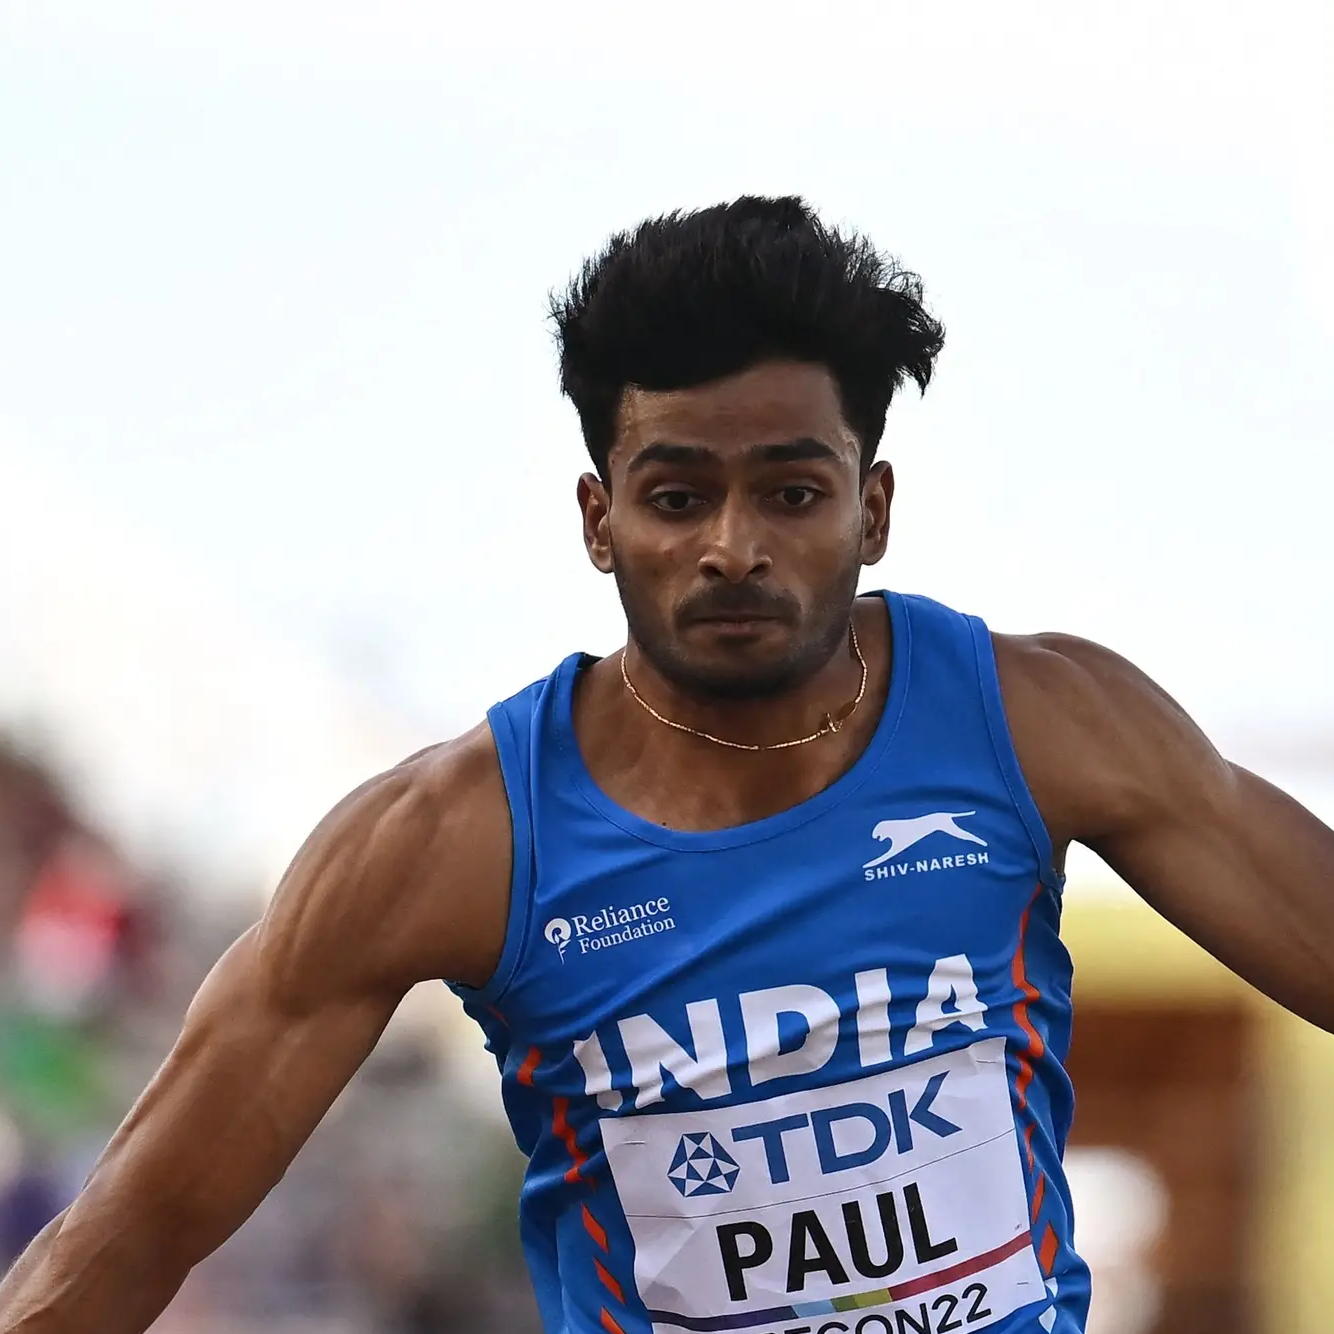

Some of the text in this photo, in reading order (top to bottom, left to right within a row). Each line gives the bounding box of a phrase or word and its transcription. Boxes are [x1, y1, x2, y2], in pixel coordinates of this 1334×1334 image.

[864, 852, 989, 881] SHIV-NARESH
[571, 896, 671, 937] Reliance
[578, 917, 676, 954] Foundation
[573, 953, 989, 1112] INDIA
[731, 1070, 963, 1185] TDK
[716, 1181, 959, 1302] PAUL
